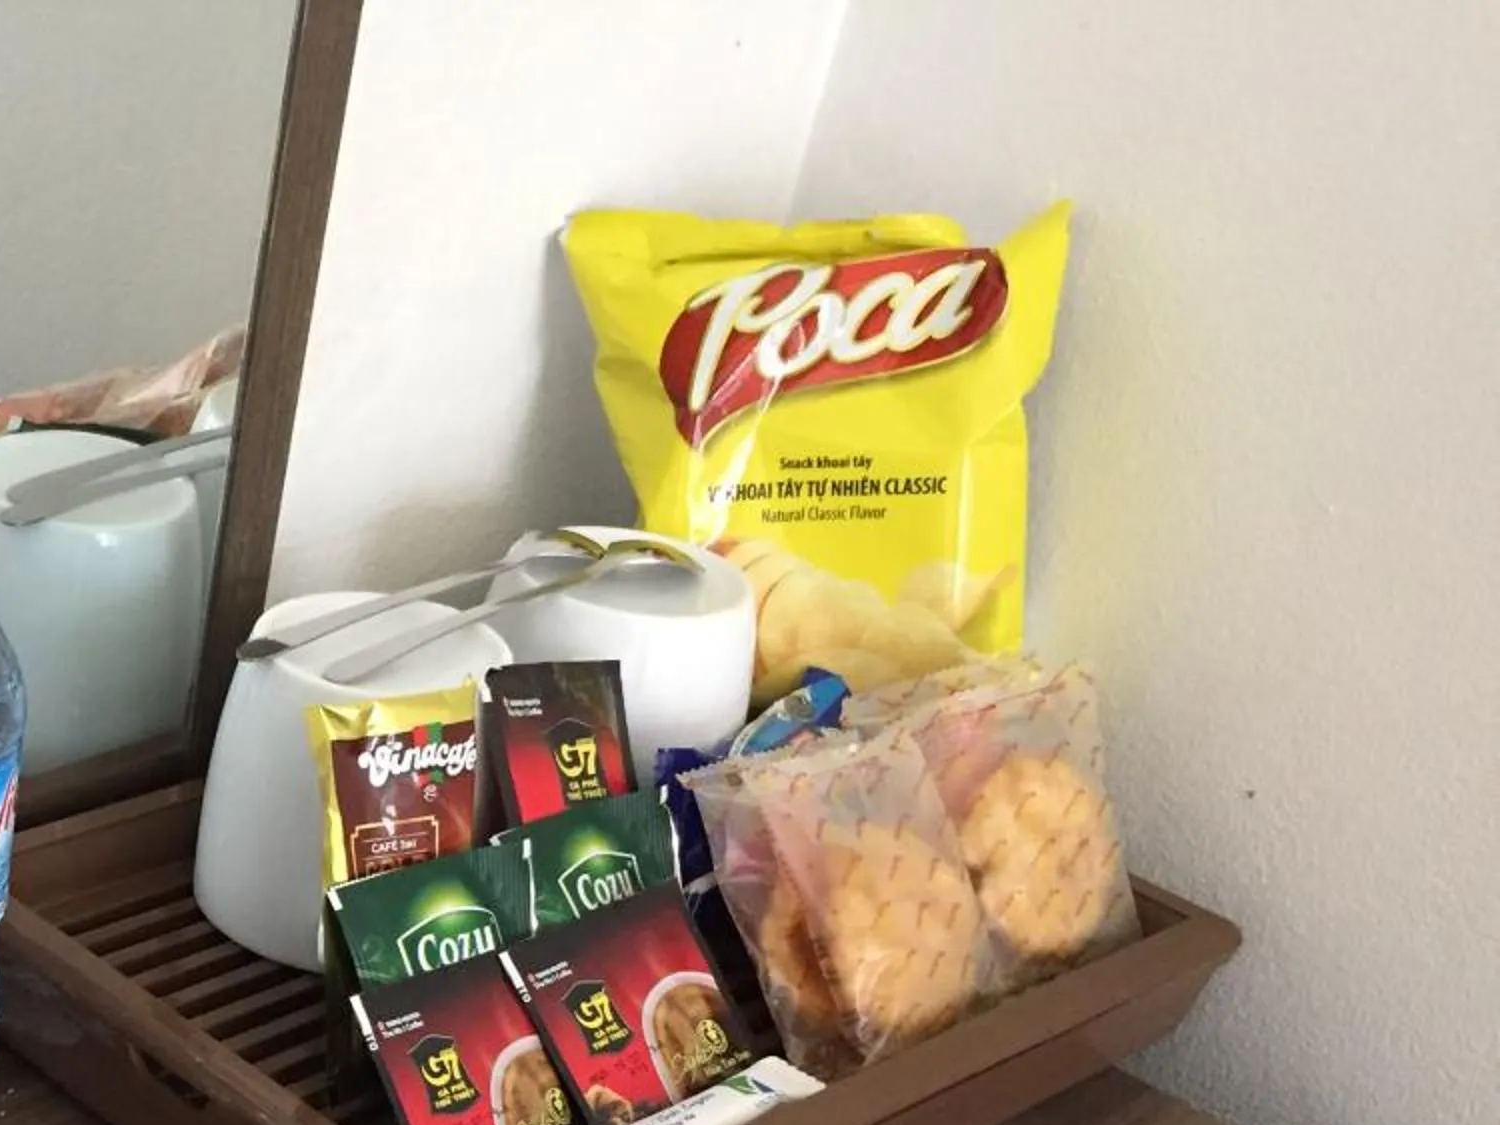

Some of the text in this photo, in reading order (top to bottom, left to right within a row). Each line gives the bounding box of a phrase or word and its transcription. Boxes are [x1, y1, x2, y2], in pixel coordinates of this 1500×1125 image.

[686, 260, 987, 413] Poca
[779, 455, 873, 471] Snack khoai tây
[777, 477, 803, 498] TÂY
[806, 477, 829, 501] TỰ
[831, 475, 881, 497] NHIÊN
[884, 476, 948, 495] CLASSIC
[761, 504, 887, 524] Natural Classic Flavor
